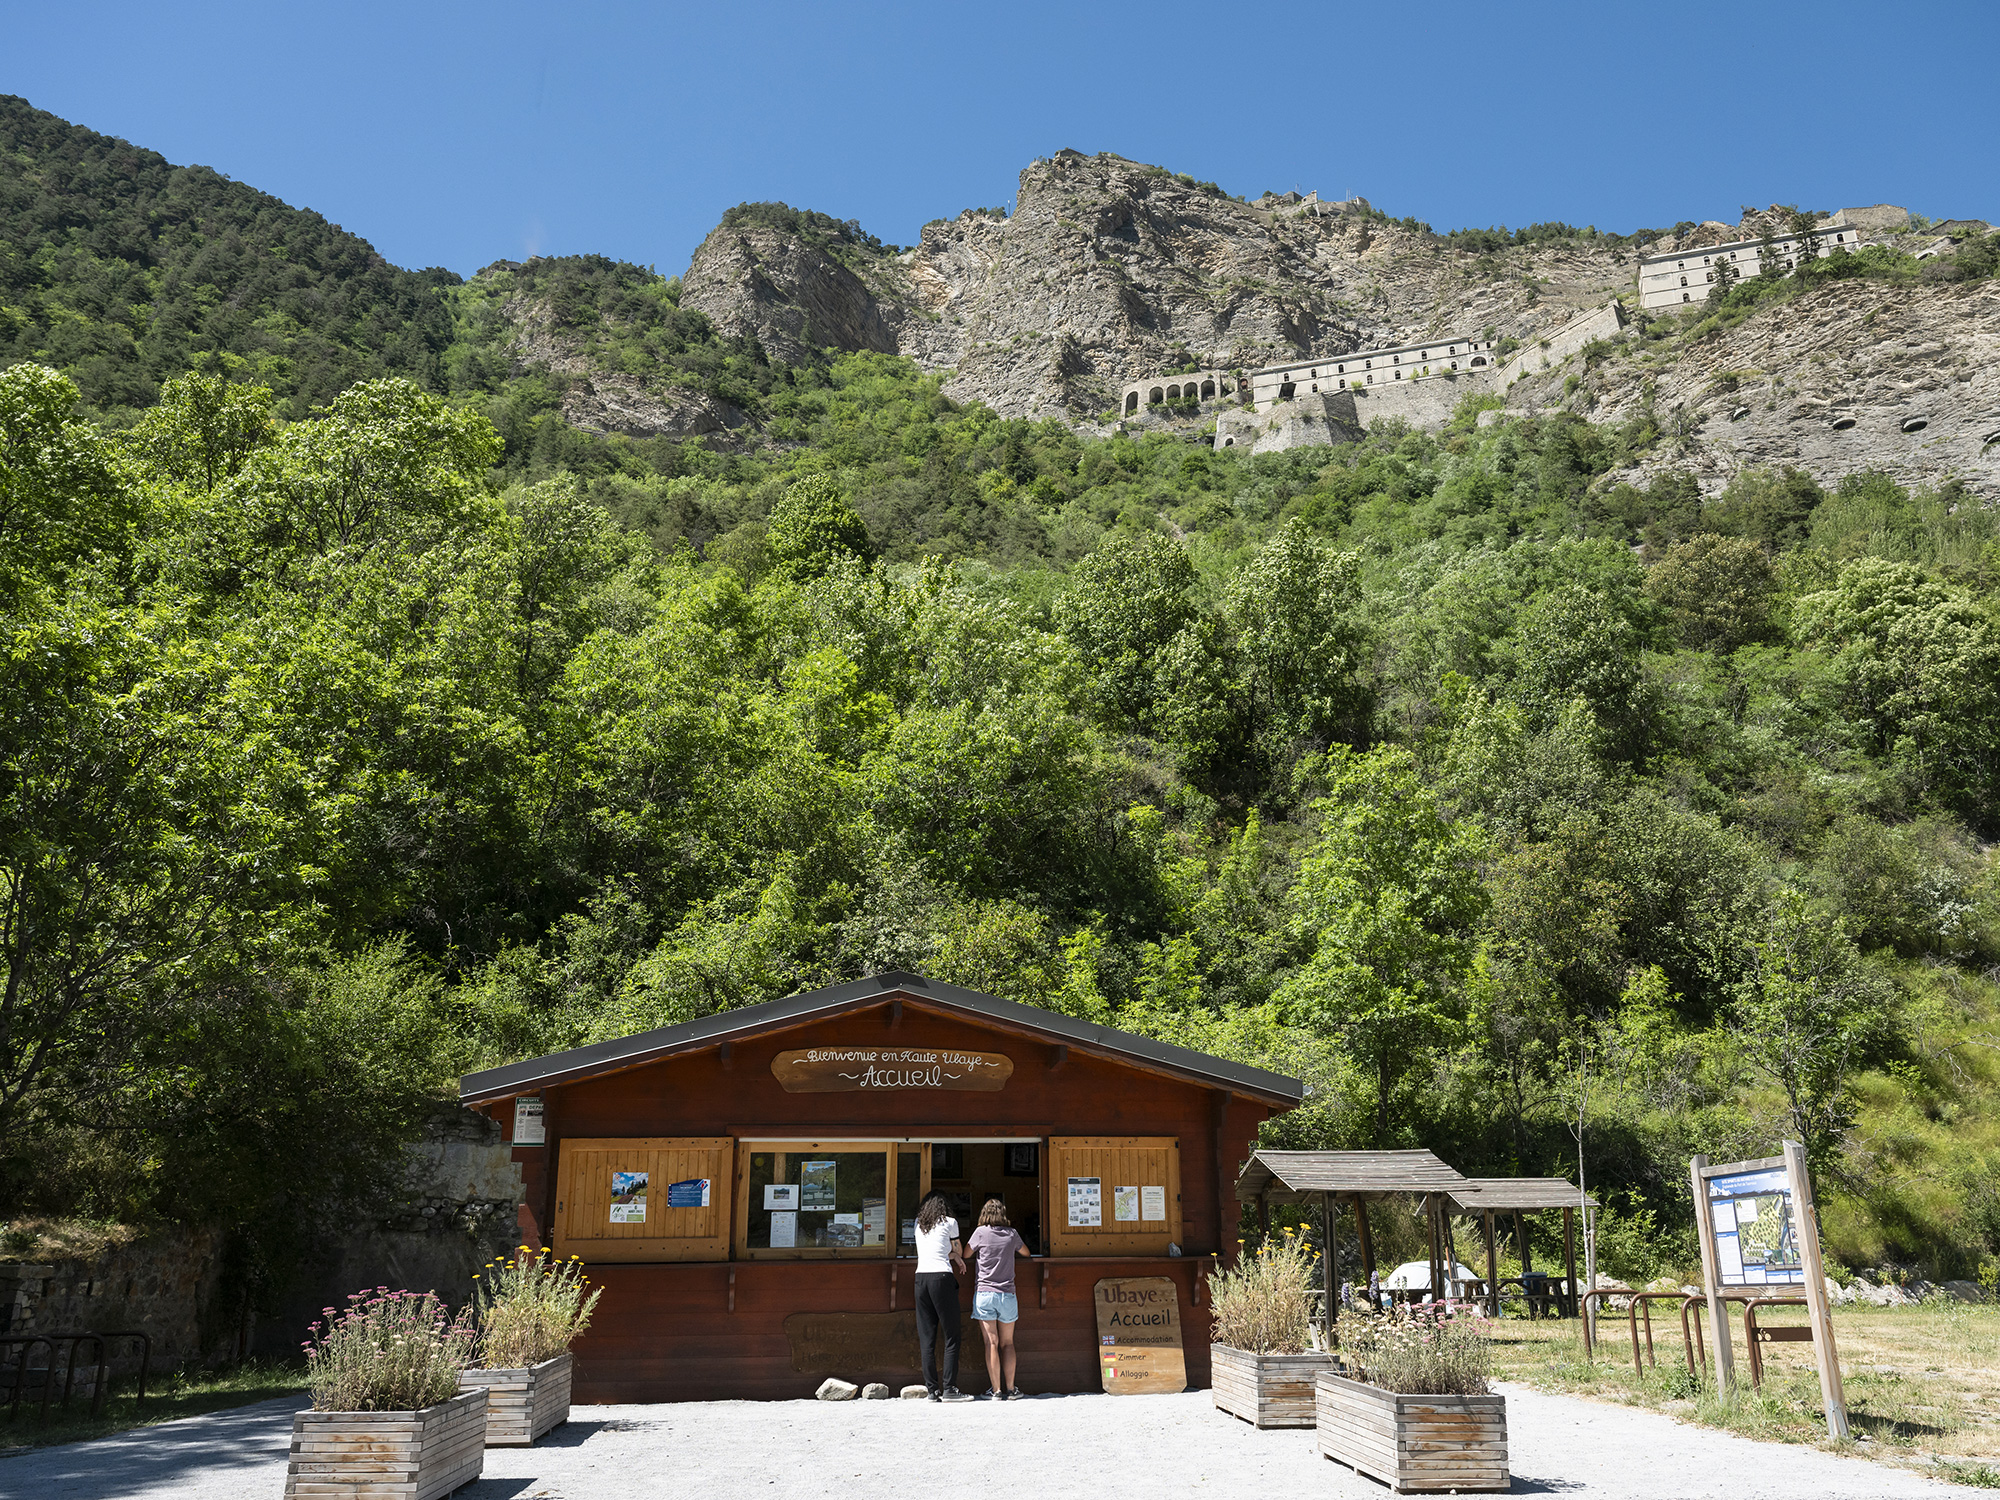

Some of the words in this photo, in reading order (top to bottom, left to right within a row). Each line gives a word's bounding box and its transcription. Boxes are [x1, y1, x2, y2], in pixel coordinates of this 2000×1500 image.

[807, 1050, 877, 1063] Bienvenue
[881, 1052, 898, 1062] en
[900, 1050, 938, 1063] Haute
[860, 1065, 942, 1087] Accueil
[1109, 1308, 1171, 1327] Accueil
[1117, 1335, 1174, 1344] Accommodation
[1117, 1354, 1147, 1362] Zimmer
[1119, 1370, 1149, 1379] Alloggio
